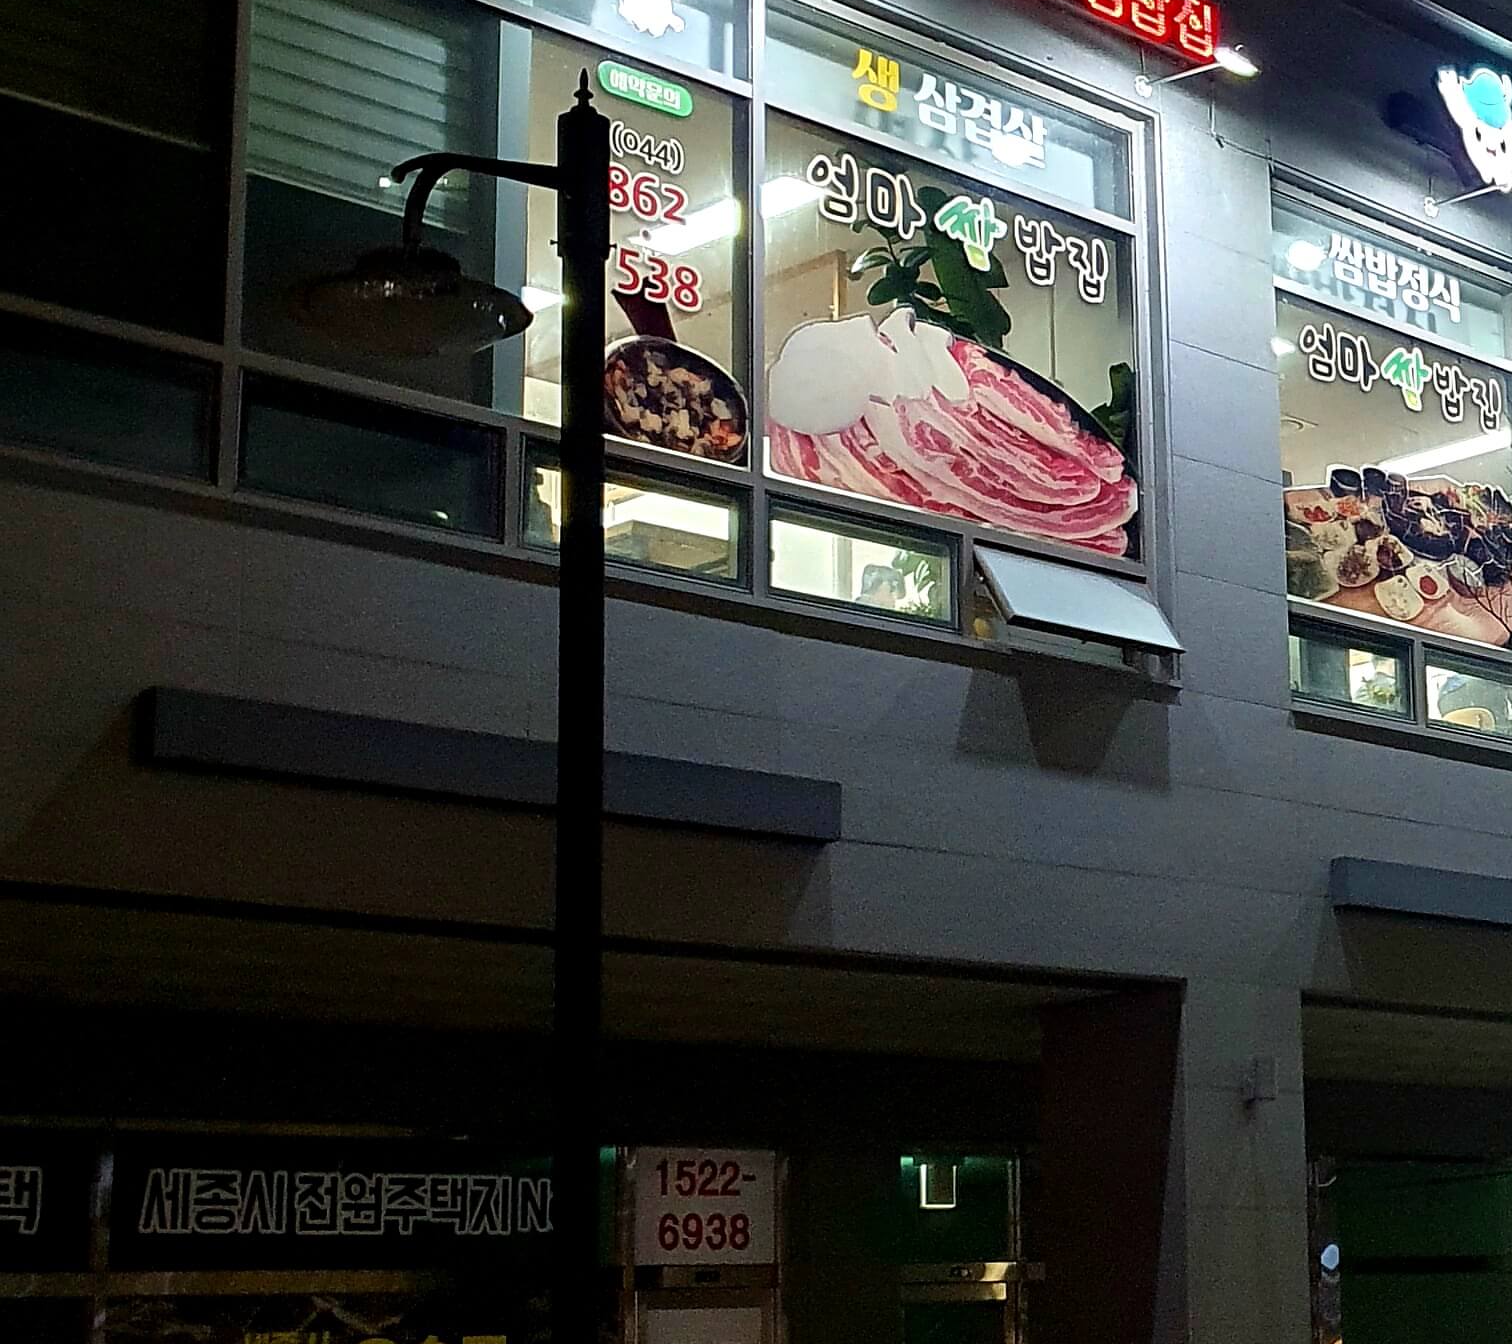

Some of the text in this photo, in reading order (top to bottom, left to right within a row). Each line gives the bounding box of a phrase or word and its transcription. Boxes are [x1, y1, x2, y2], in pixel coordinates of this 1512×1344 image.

[852, 48, 1048, 169] 생 삼겹살
[609, 121, 685, 174] (044)
[608, 163, 689, 226] 862
[613, 246, 702, 311] 538
[1328, 233, 1461, 324] 쌈밥정식
[138, 1168, 287, 1234] 세종시
[295, 1170, 512, 1235] 전원주택지
[655, 1159, 757, 1197] 1522-
[657, 1212, 752, 1251] 6938
